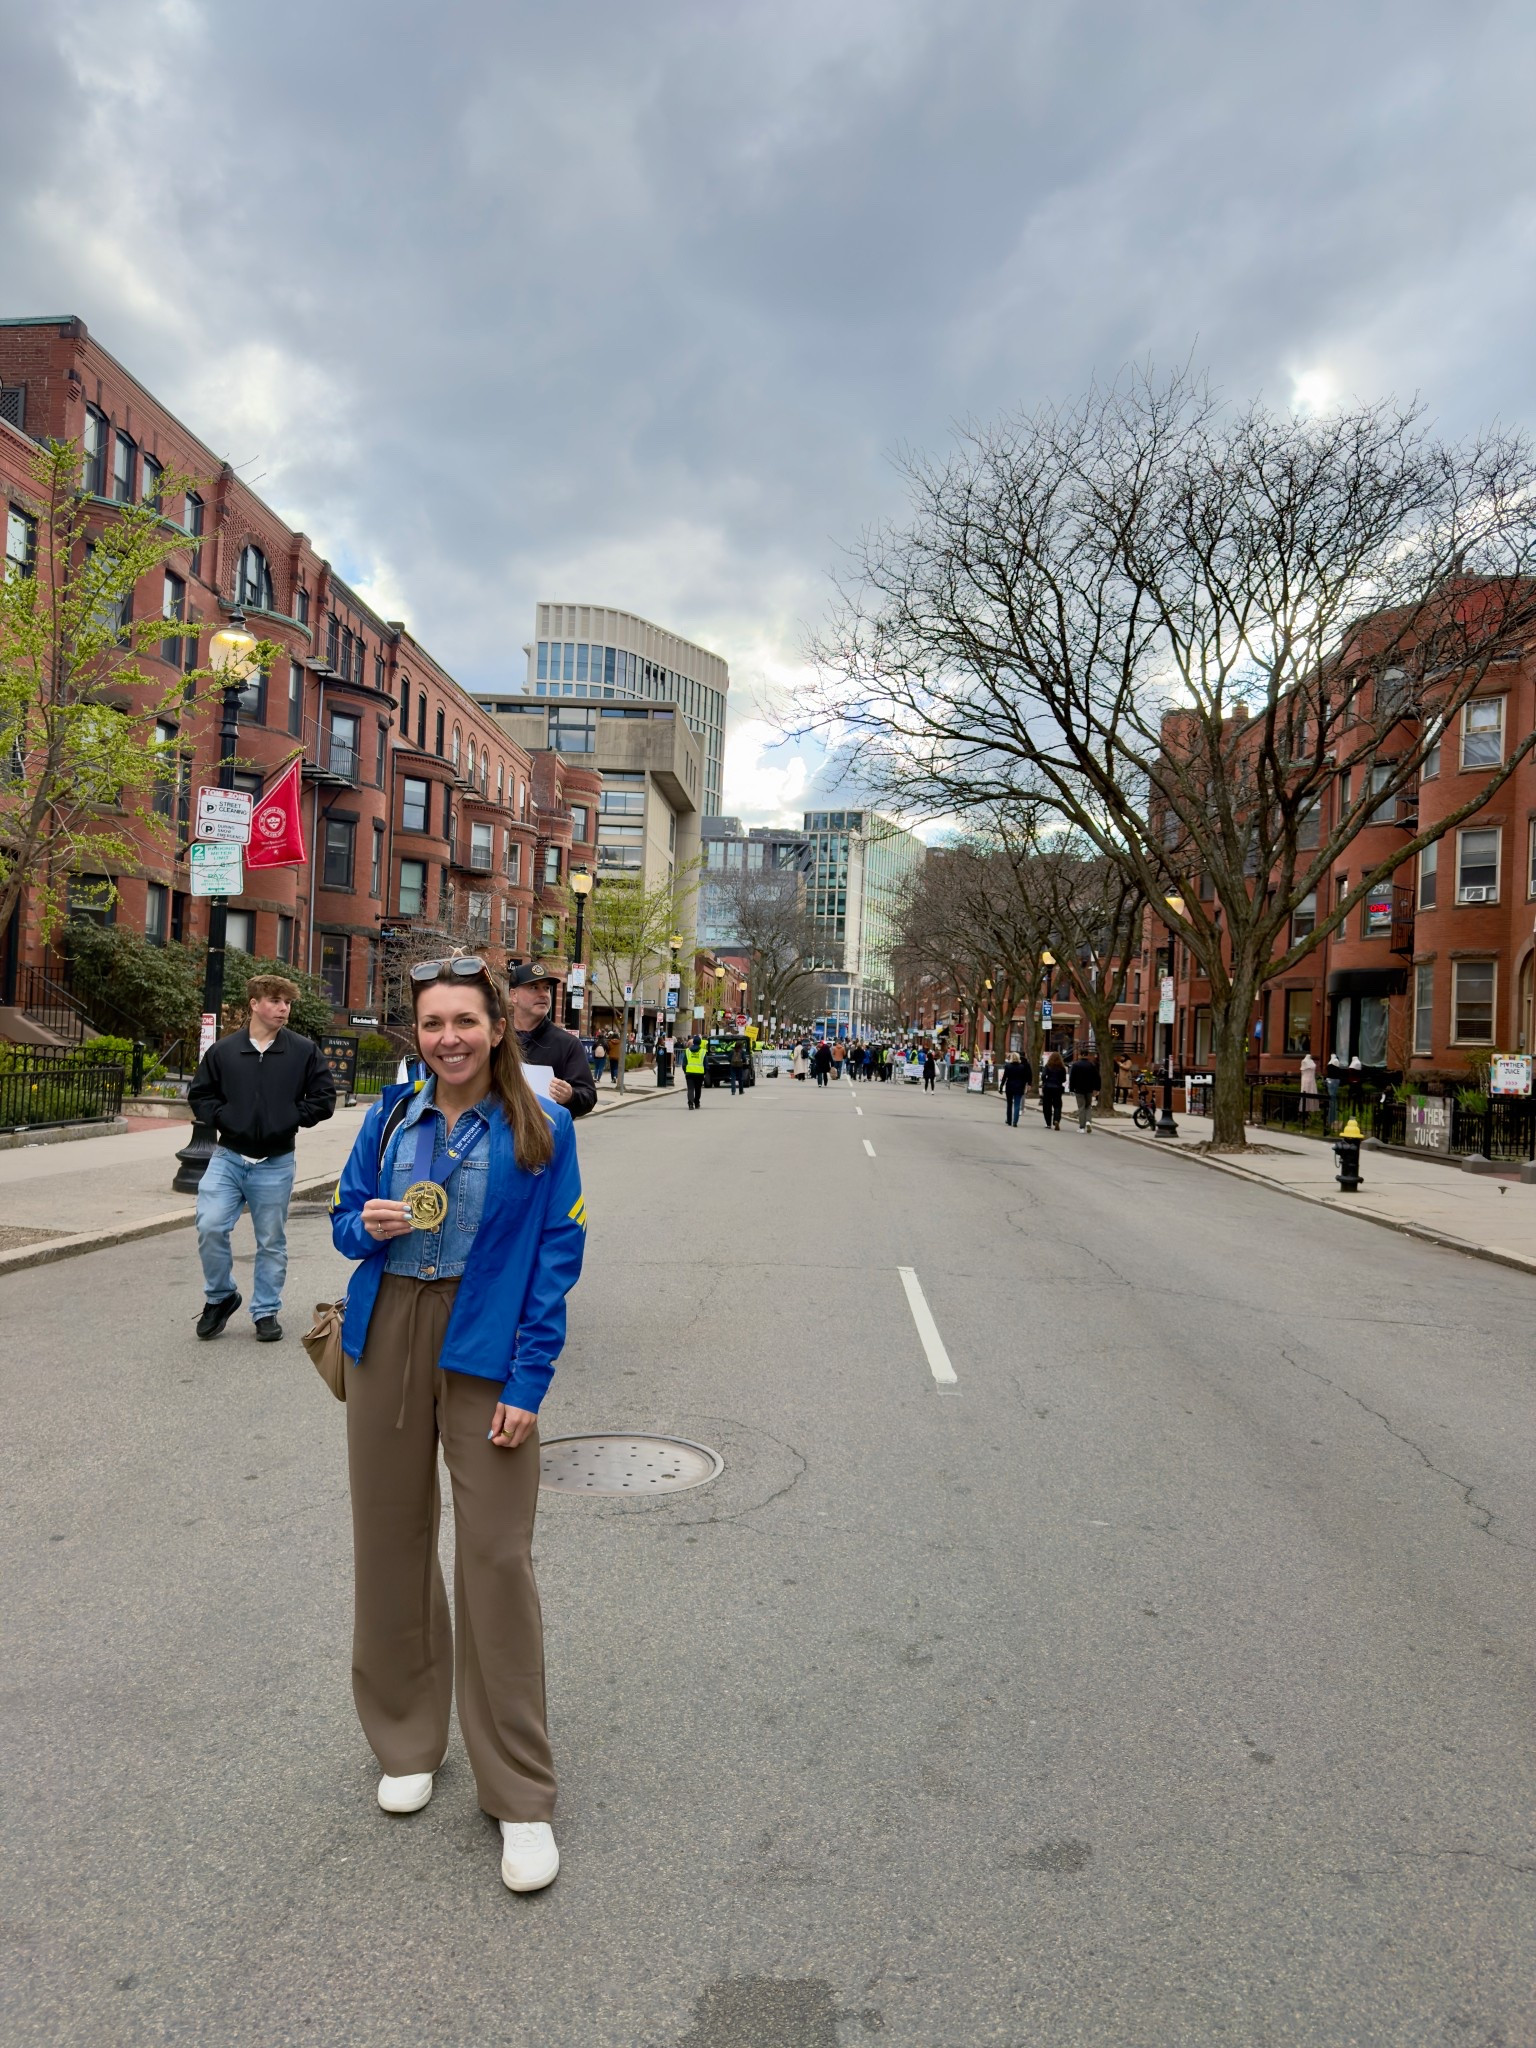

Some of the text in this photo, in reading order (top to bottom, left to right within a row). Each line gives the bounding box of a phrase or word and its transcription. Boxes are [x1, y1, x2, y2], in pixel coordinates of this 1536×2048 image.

[205, 789, 249, 802] TOW ZONE
[219, 801, 242, 809] STREET
[218, 807, 248, 815] CLEANING
[194, 846, 204, 857] 2
[1372, 883, 1390, 895] 297
[1370, 904, 1388, 913] OPEN
[461, 1126, 476, 1142] BOSTON
